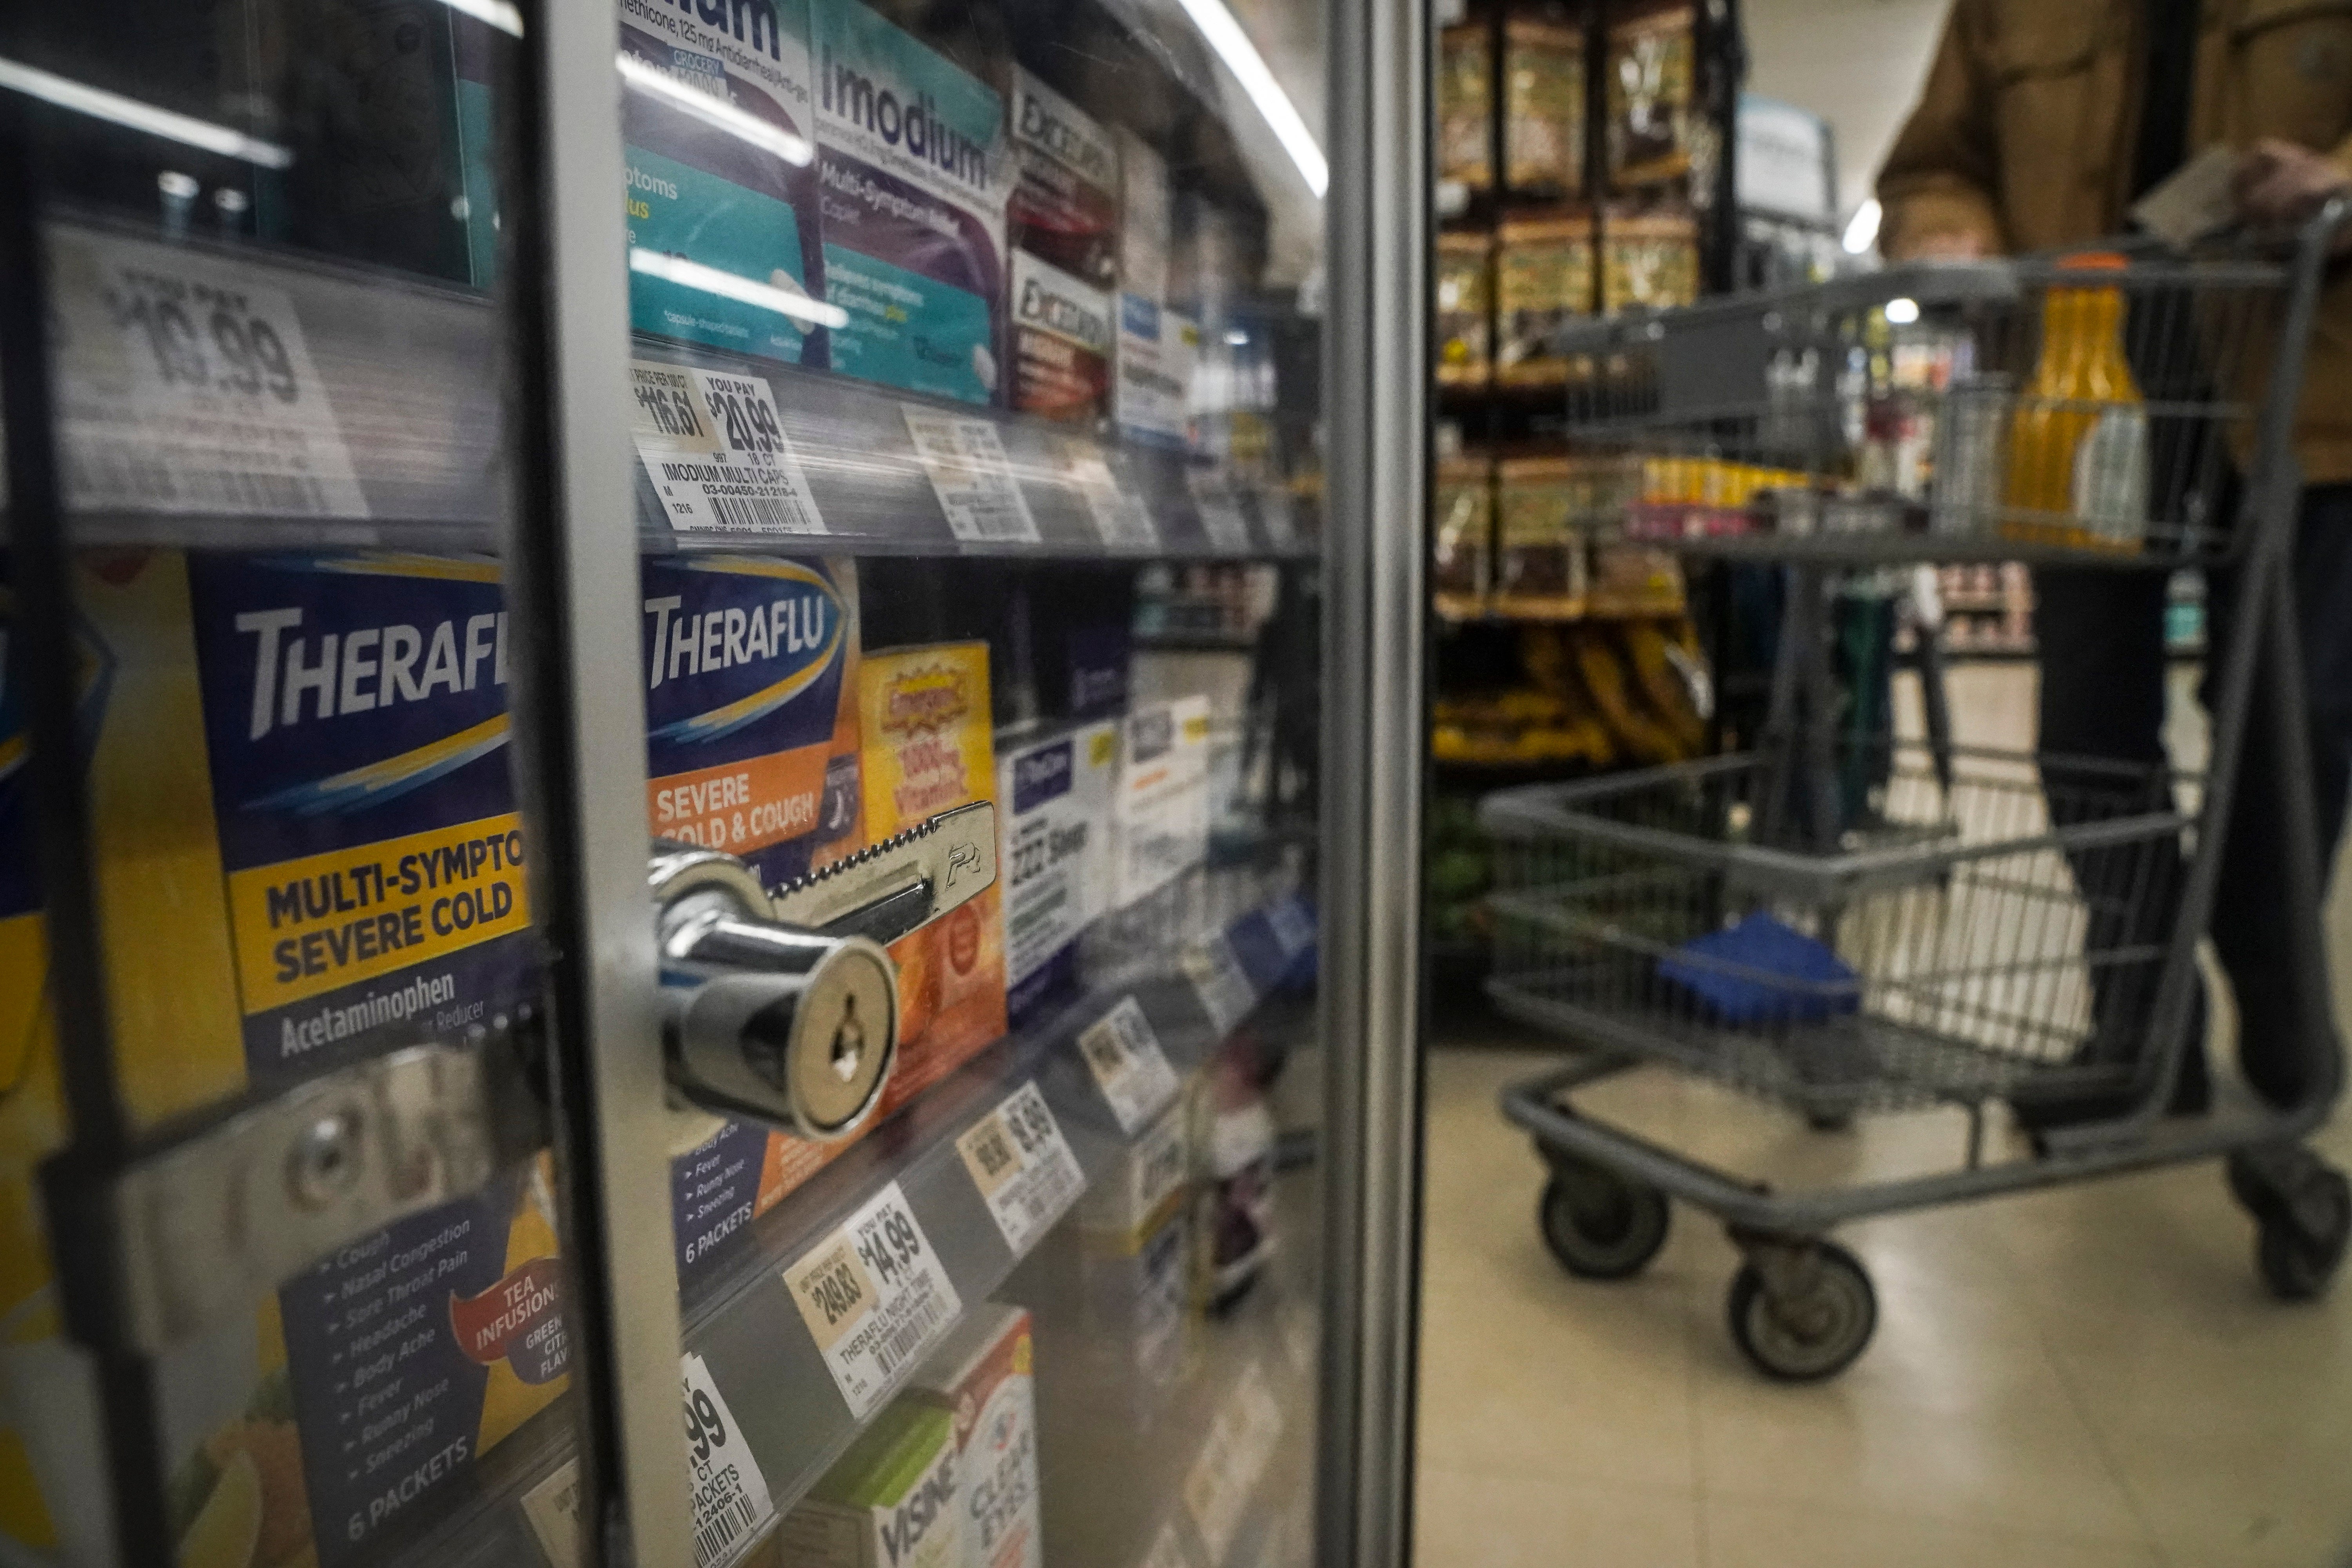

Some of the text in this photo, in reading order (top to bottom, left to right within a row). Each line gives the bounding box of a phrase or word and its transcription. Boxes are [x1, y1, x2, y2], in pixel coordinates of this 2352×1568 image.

[679, 0, 780, 62] um
[679, 18, 697, 44] 125
[821, 44, 986, 191] Imodium
[633, 385, 704, 437] $116.61
[706, 377, 755, 397] YOU PAY
[705, 391, 784, 453] $20.99
[662, 463, 789, 485] IMODIUM MULTI CAPS
[763, 453, 776, 466] CT
[672, 503, 693, 514] 1216
[645, 595, 824, 690] THERAFLU
[657, 773, 750, 822] SEVERE
[731, 812, 745, 843] &
[750, 792, 814, 836] COUGH
[266, 829, 523, 929] MULTI-SYMPTO
[274, 881, 512, 983] SEVERE COLD
[280, 973, 455, 1058] Acetaminophen
[695, 1154, 721, 1176] Fever
[337, 1232, 390, 1269] Cough
[341, 1220, 470, 1299] Nasal Congestion
[686, 1200, 752, 1264] 6 PACKETS
[858, 1210, 920, 1286] $14.99
[387, 1267, 435, 1303] Throat
[437, 1250, 468, 1278] Pain
[503, 1275, 535, 1308] TEA
[350, 1303, 427, 1357] Headache
[476, 1282, 558, 1351] INFUSION
[526, 1315, 563, 1350] GREEN
[839, 1311, 890, 1369] THERAFLU
[353, 1328, 436, 1388] Body Ache
[358, 1376, 404, 1417] Fever
[361, 1377, 449, 1445] Runny Nose
[365, 1417, 434, 1475] Sneezing
[697, 1459, 713, 1482] CT
[348, 1434, 469, 1541] 6 PACKETS
